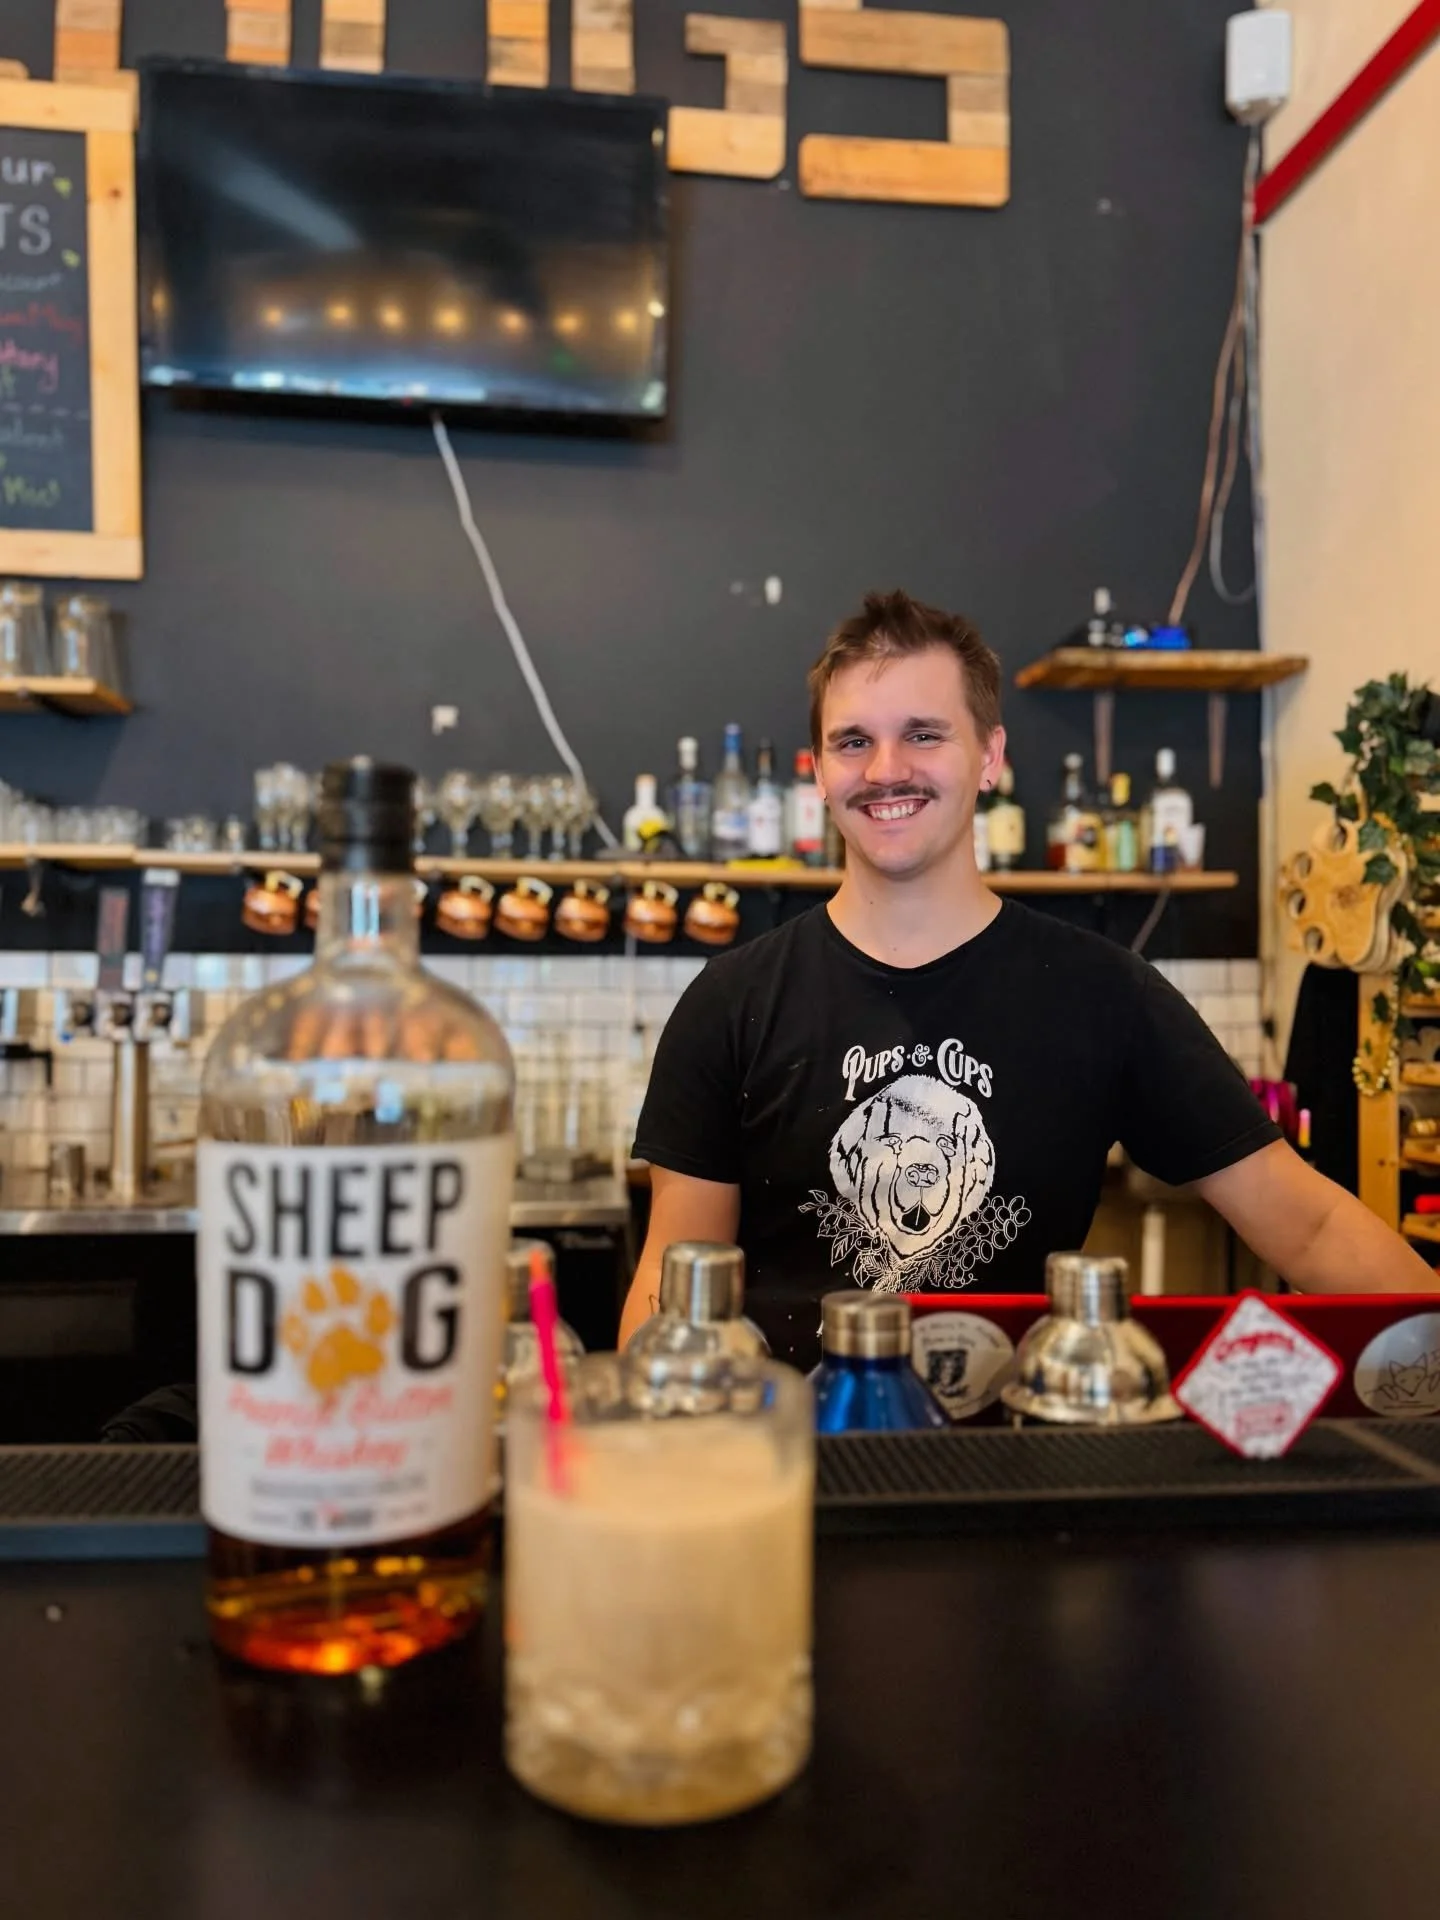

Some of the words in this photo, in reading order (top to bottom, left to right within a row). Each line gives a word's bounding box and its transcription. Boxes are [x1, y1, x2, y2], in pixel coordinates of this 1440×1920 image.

[911, 1043, 931, 1068] &
[225, 1160, 465, 1260] SHEEP
[225, 1263, 462, 1378] DG
